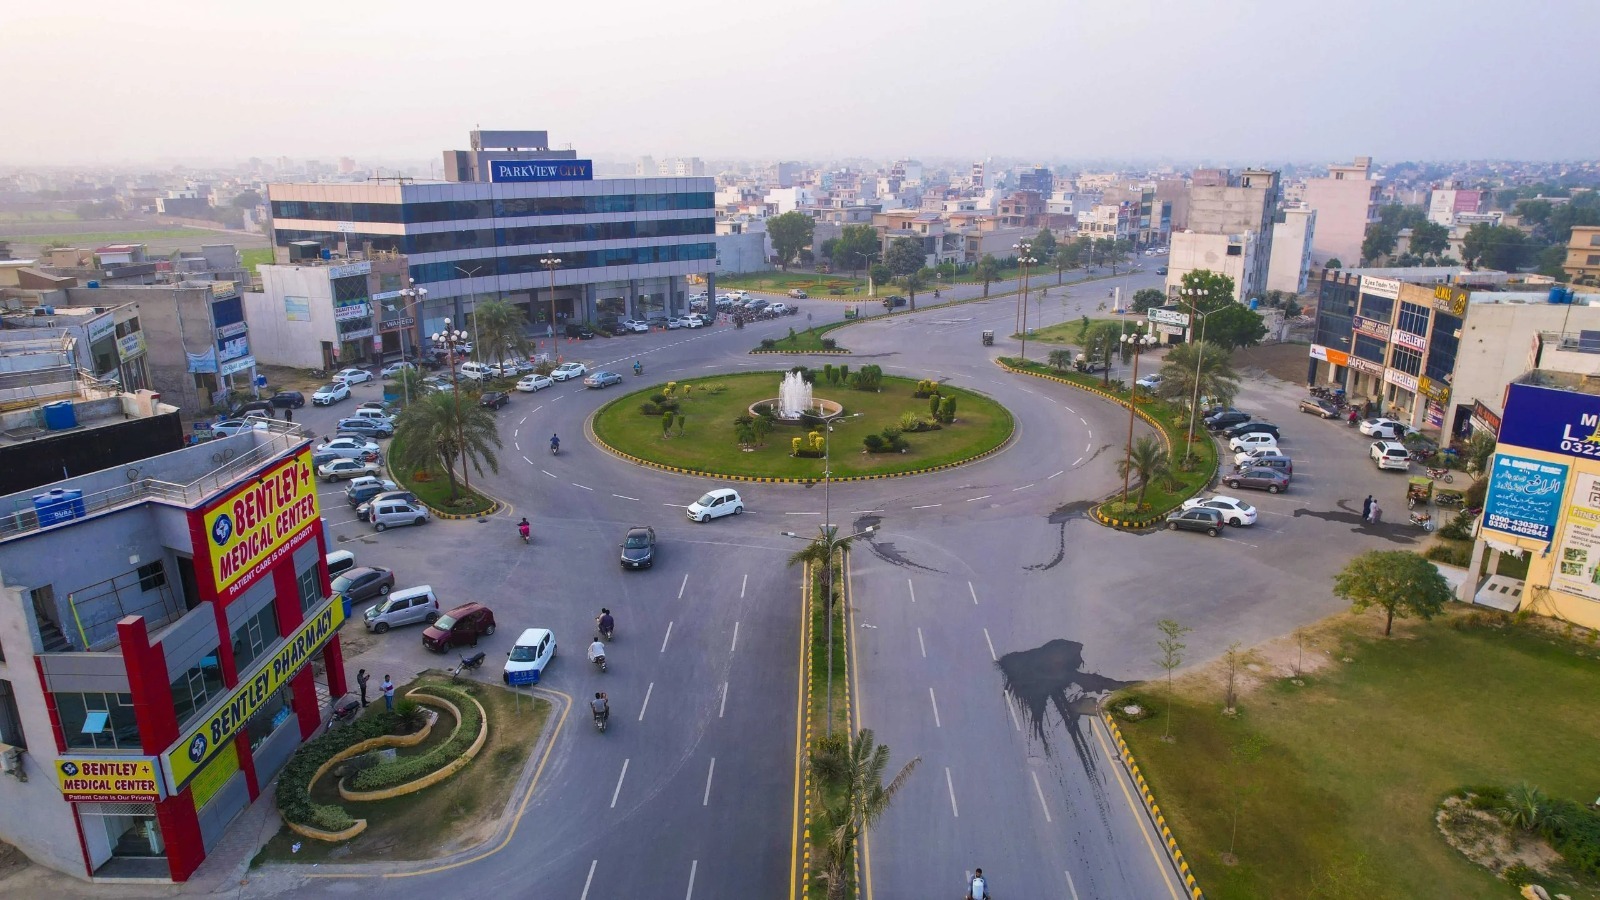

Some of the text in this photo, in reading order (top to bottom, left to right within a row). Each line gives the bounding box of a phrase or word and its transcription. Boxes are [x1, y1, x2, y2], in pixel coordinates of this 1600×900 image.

[560, 166, 586, 176] CITY
[1347, 356, 1365, 370] HAFIZ
[233, 464, 299, 537] BENTLEY
[219, 493, 315, 582] MEDICAL CENTER
[229, 525, 313, 595] PATIENT CARE IS OUR PRIORITY
[210, 607, 332, 746] BENTLEY PHARMACY
[64, 780, 155, 791] MEDICAL CENTER
[81, 763, 138, 776] BENTLEY
